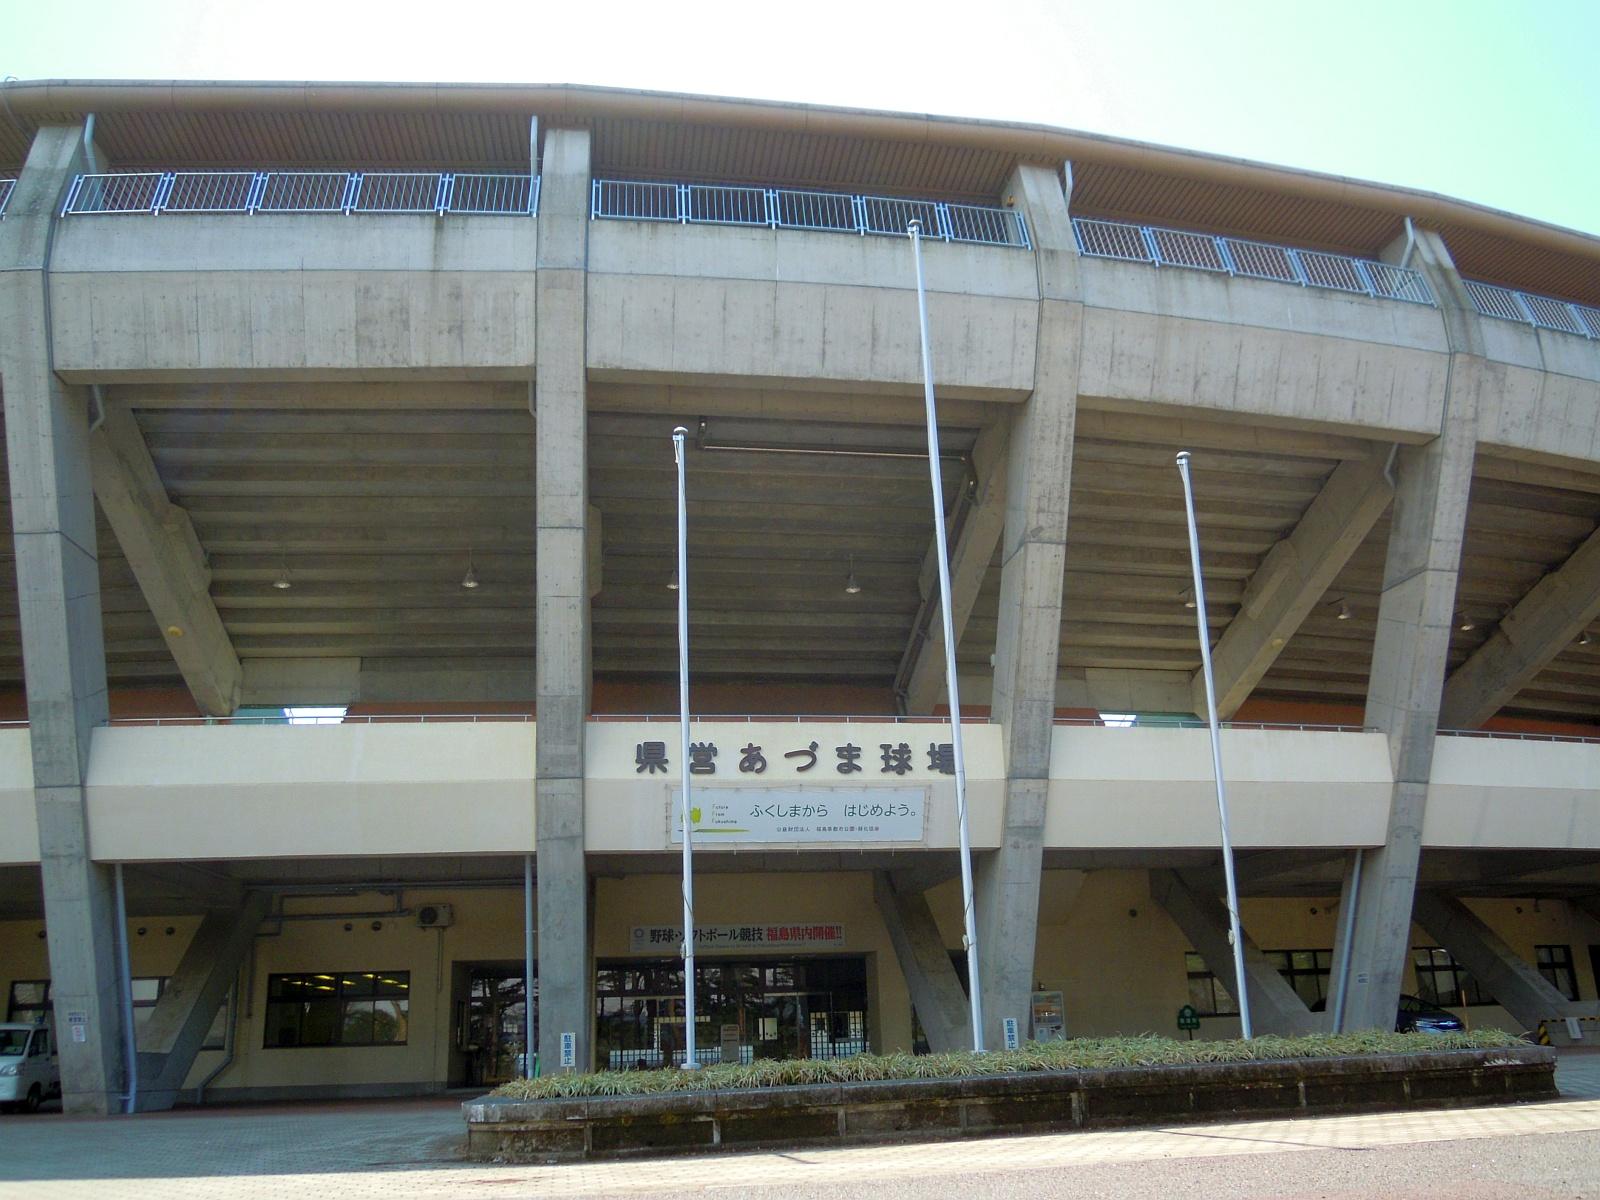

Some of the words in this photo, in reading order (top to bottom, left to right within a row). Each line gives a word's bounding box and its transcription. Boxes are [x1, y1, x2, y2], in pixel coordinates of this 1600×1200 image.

[635, 740, 956, 775] 県営あづま球場
[750, 804, 829, 818] ふくしまから
[844, 804, 917, 818] はじめよう。
